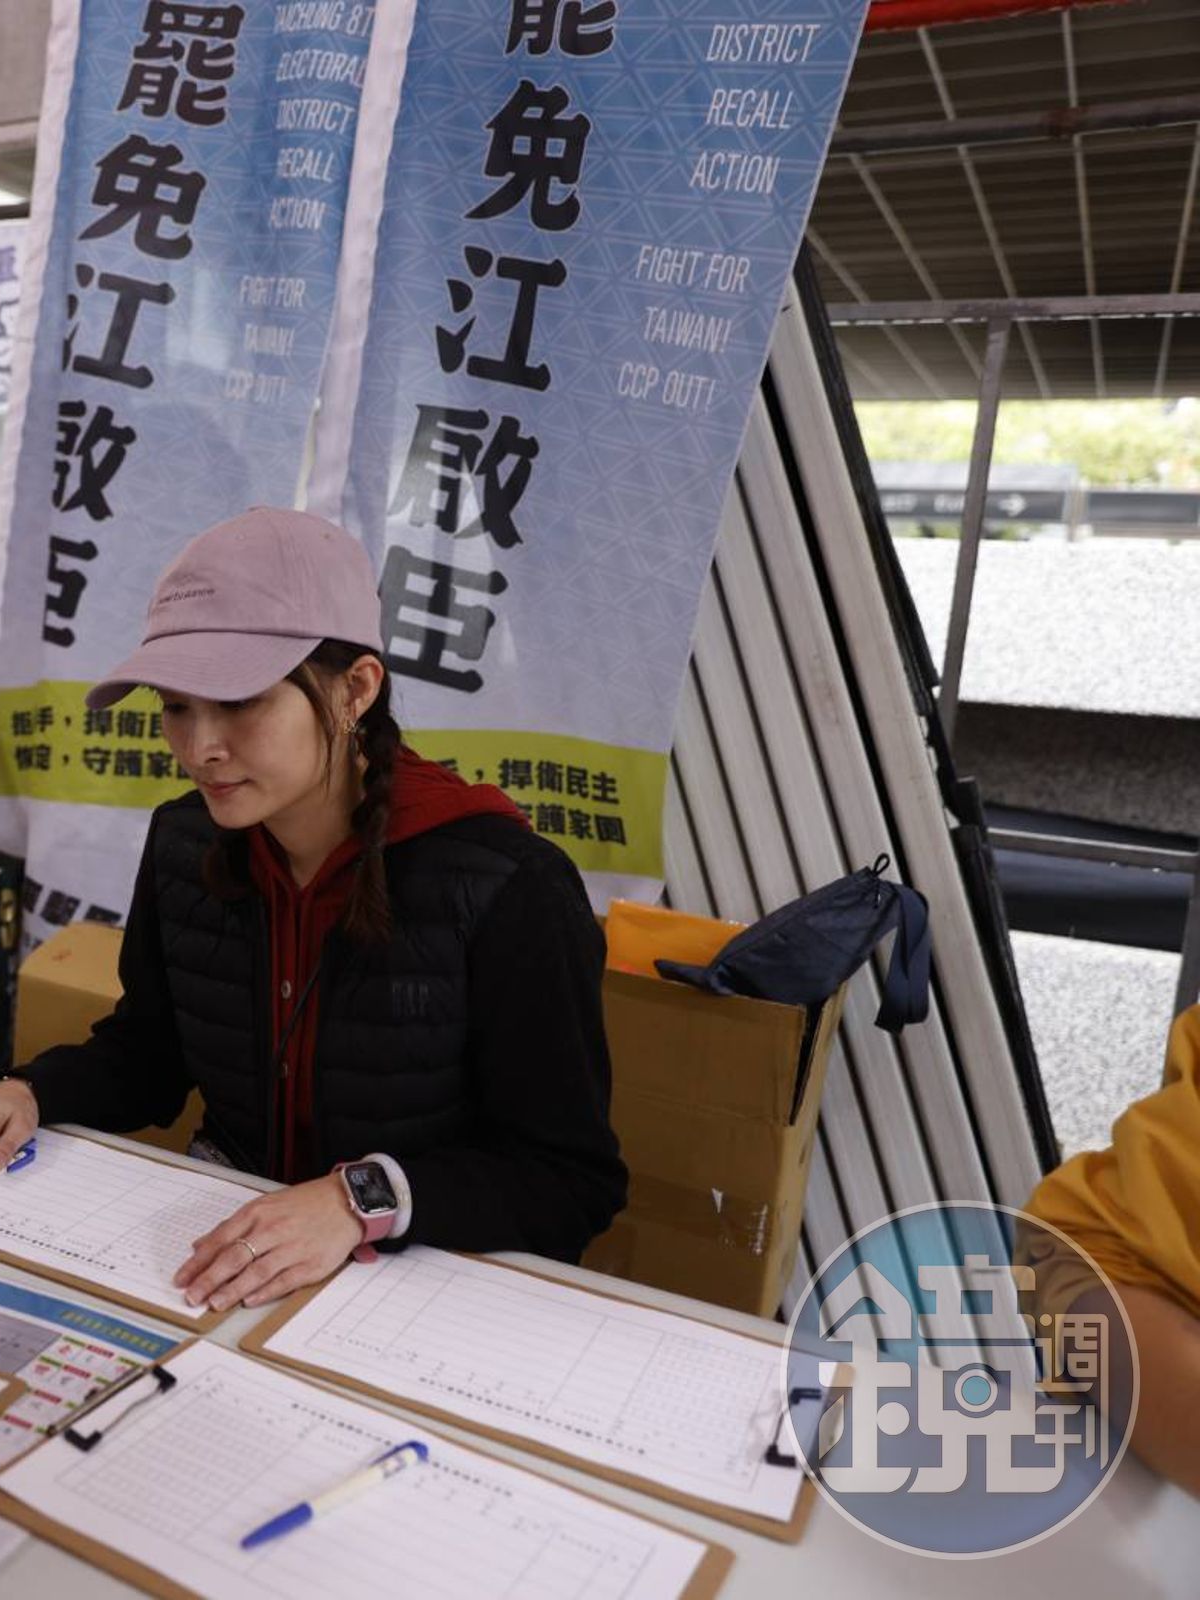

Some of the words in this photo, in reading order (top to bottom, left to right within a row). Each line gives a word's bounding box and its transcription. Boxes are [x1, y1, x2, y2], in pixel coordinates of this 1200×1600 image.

[706, 24, 820, 63] DISTRICT
[705, 88, 793, 131] RECALL
[689, 151, 781, 195] ACTION
[635, 244, 704, 286] FIGHT
[703, 253, 751, 294] FOR
[643, 306, 732, 355] TAIWAN!
[618, 361, 660, 400] CCP
[661, 369, 717, 409] OUT!
